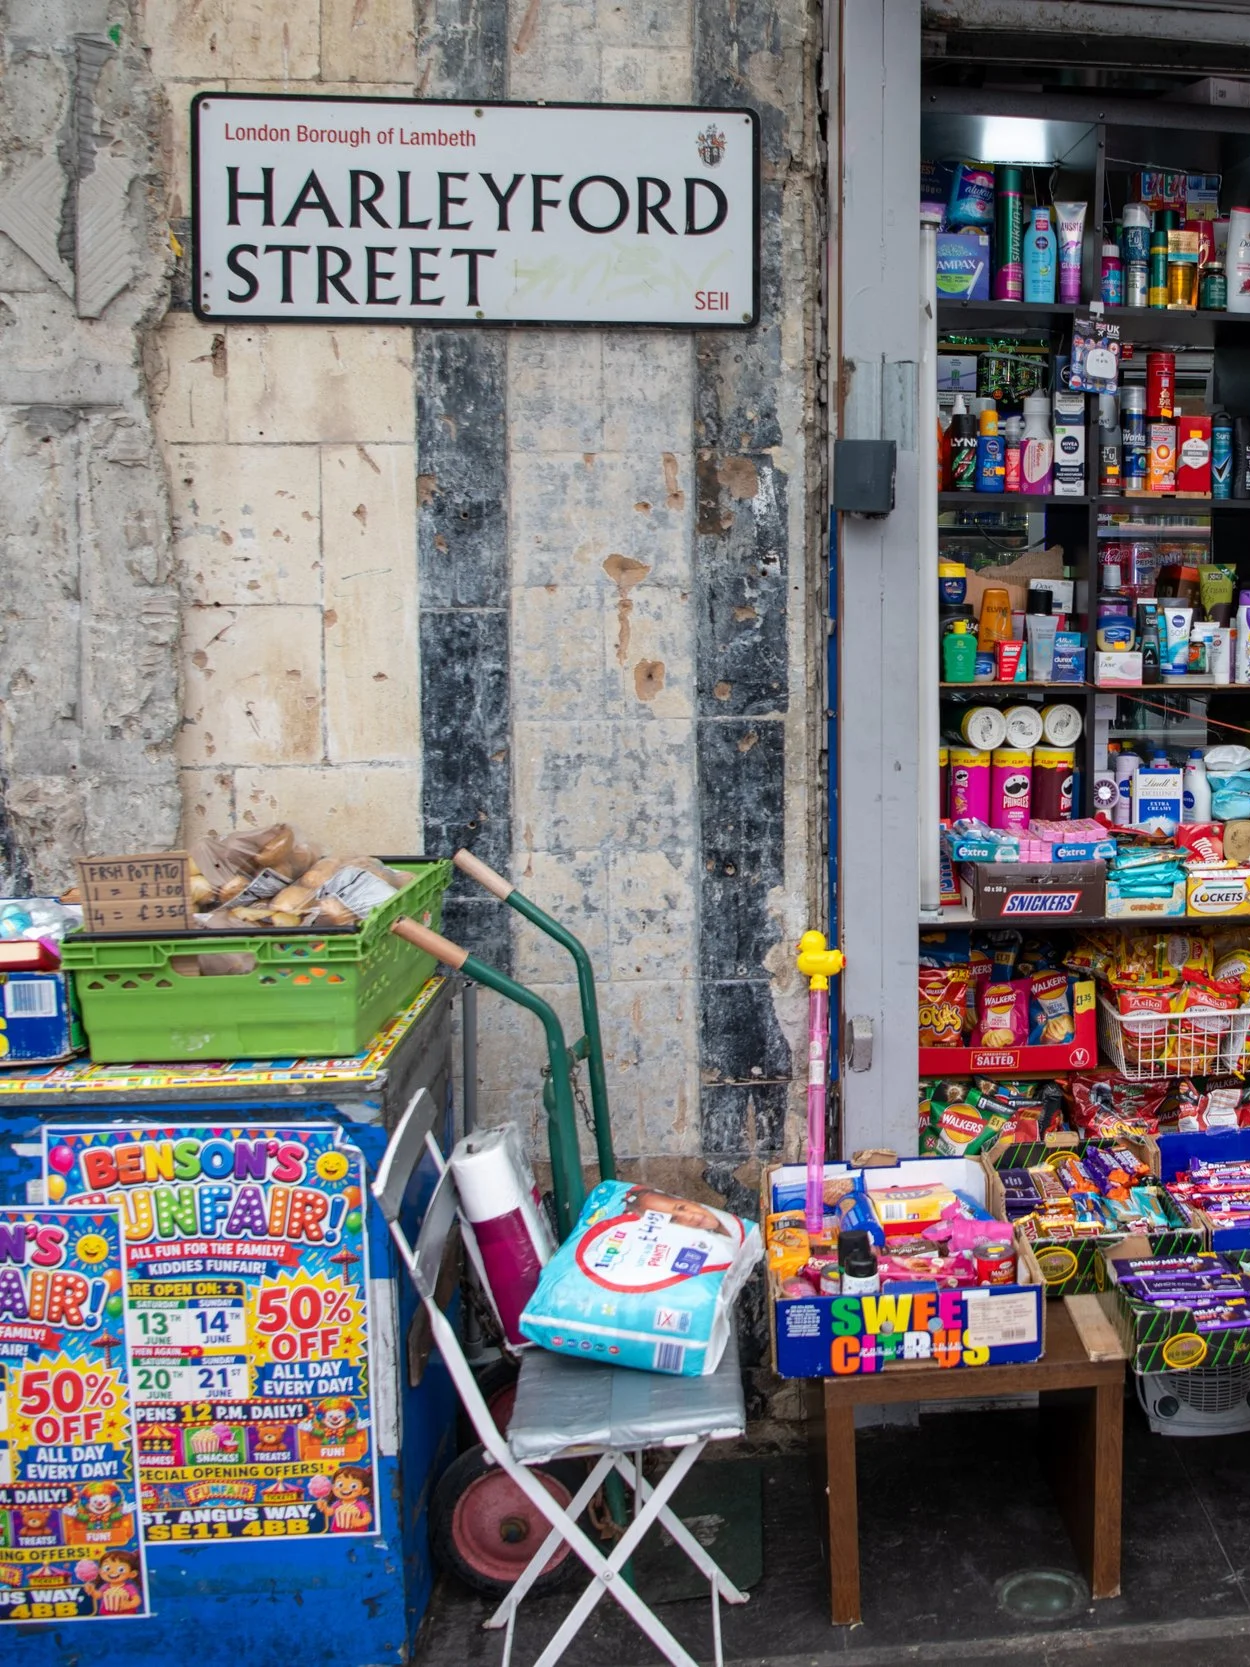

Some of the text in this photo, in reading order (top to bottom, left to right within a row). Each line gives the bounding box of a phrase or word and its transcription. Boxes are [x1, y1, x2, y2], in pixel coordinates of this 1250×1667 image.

[225, 123, 476, 148] London Borough of Lambeth
[226, 166, 728, 236] HARLEYFORD
[937, 260, 976, 270] AMPAX
[226, 244, 497, 307] STREET
[1107, 325, 1120, 334] UK
[951, 438, 978, 447] LYNX
[1003, 796, 1029, 808] PRINGLES
[959, 846, 988, 857] extra
[1058, 846, 1086, 857] extra
[1006, 895, 1076, 911] SNICKERS
[1193, 891, 1243, 903] LOCKETS
[1031, 976, 1067, 994] WALKERS
[985, 994, 1017, 1006] WALKERS
[1131, 999, 1161, 1008] Asiko
[976, 1056, 1013, 1066] SALTED
[942, 1113, 984, 1134] WALKERS
[84, 1140, 306, 1190] BENSON'S
[131, 1243, 285, 1260] ALL FUN FOR THE FAMILY!
[148, 1260, 267, 1275] KIDDIES FUNFAIR!
[1162, 1258, 1186, 1266] MILK
[154, 1283, 192, 1296] OPEN
[258, 1287, 351, 1332] 50%
[203, 1335, 232, 1343] JUNE
[272, 1328, 340, 1361] OFF
[272, 1361, 342, 1379] ALL DAY
[263, 1376, 353, 1395] EVERY DAY!
[19, 1370, 115, 1417] 50%
[147, 1391, 173, 1399] JUNE
[181, 1404, 211, 1422] 12
[252, 1404, 303, 1419] DAILY!
[34, 1412, 103, 1444] OFF
[36, 1445, 106, 1464] ALL DAY
[320, 1448, 345, 1457] FUN!
[27, 1460, 117, 1480] EVERY DAY!
[193, 1467, 259, 1478] OPENING
[264, 1463, 324, 1476] OFFERS!
[14, 1489, 68, 1503] DAILY!
[179, 1507, 259, 1523] ANGUS
[86, 1532, 111, 1542] FUN!
[148, 1519, 309, 1540] SE11 4BB
[29, 1548, 90, 1559] OFFERS!
[10, 1602, 78, 1618] 4BB
